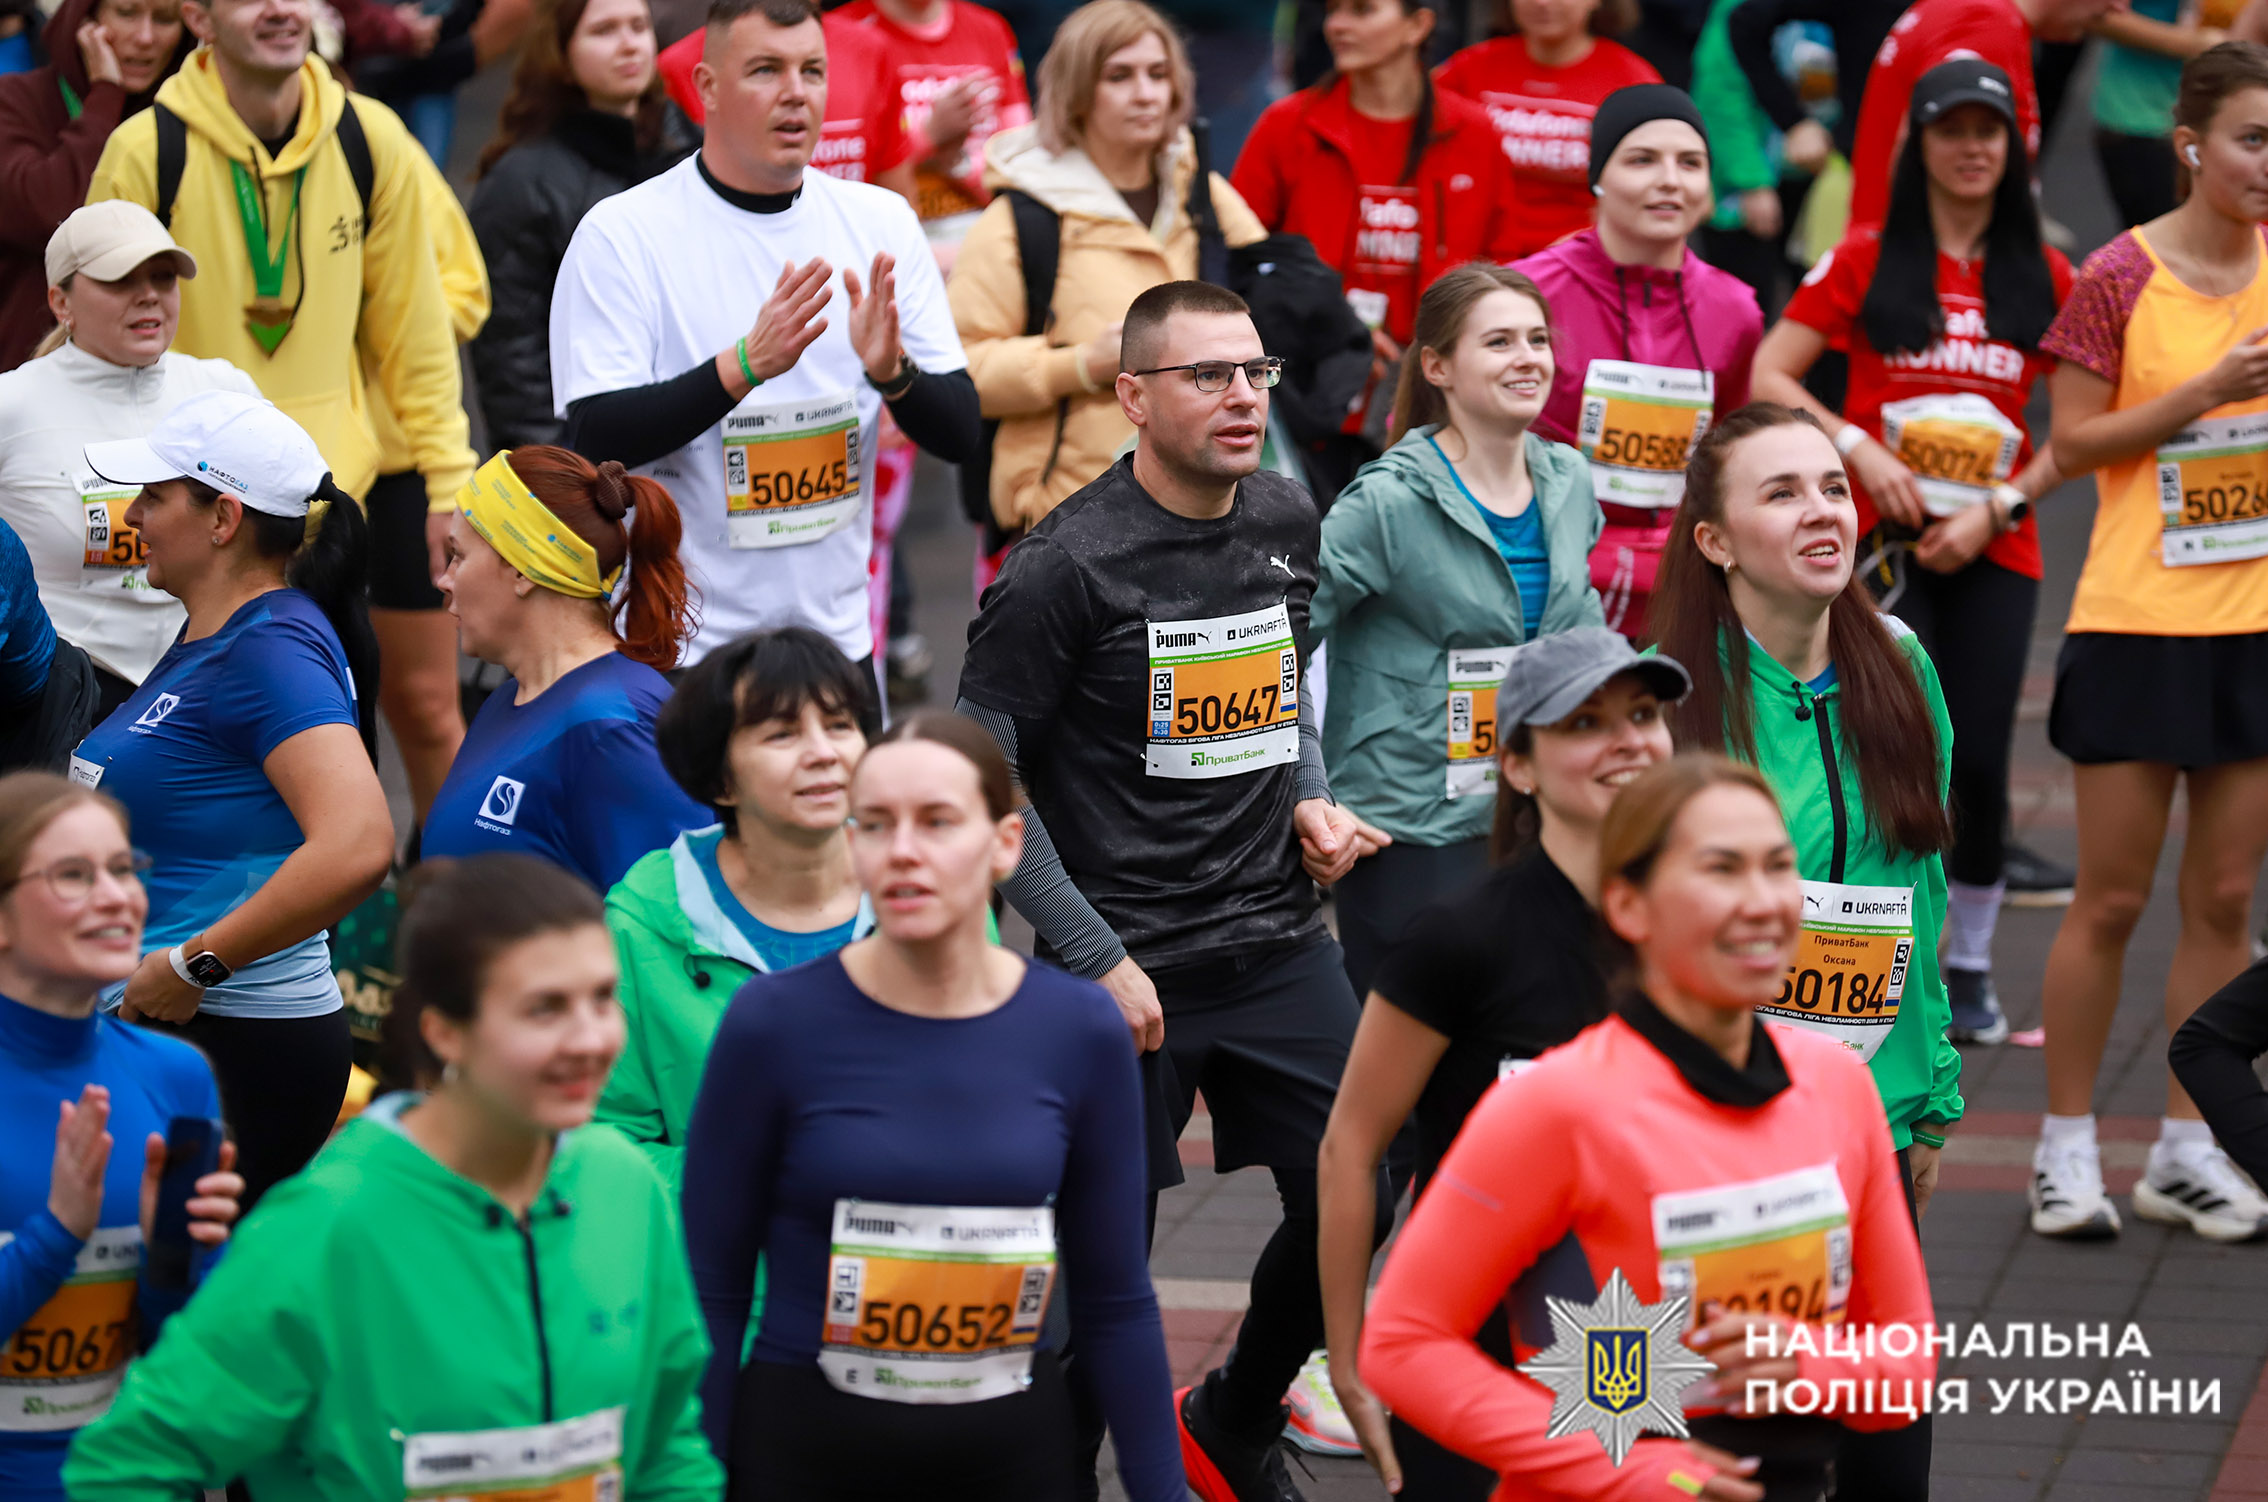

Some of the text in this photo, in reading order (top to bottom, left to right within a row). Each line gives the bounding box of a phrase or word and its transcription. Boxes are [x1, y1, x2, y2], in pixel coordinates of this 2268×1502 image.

[728, 415, 765, 428] PUMA
[209, 466, 248, 490] НАФТОГАЗ
[752, 462, 846, 506] 50645
[2185, 482, 2268, 521] 5026
[1156, 617, 1288, 648] PUMA UKRNAFTA
[1226, 650, 1250, 658] МАРАФОН
[1177, 684, 1278, 735] 50647
[1225, 727, 1263, 739] НЕЗЛАМНОСТІ
[1474, 721, 1497, 753] 5
[1206, 748, 1265, 766] ПриватБанк
[474, 818, 511, 836] Нафтогаз
[1856, 902, 1907, 915] UKRNAFTA
[1814, 935, 1870, 948] ПриватБанк
[1823, 954, 1856, 966] Оксана
[1776, 1009, 1802, 1018] БІГОВА
[1821, 1016, 1866, 1024] НЕЗЛАМНОСТІ
[862, 1302, 1011, 1347] 50652
